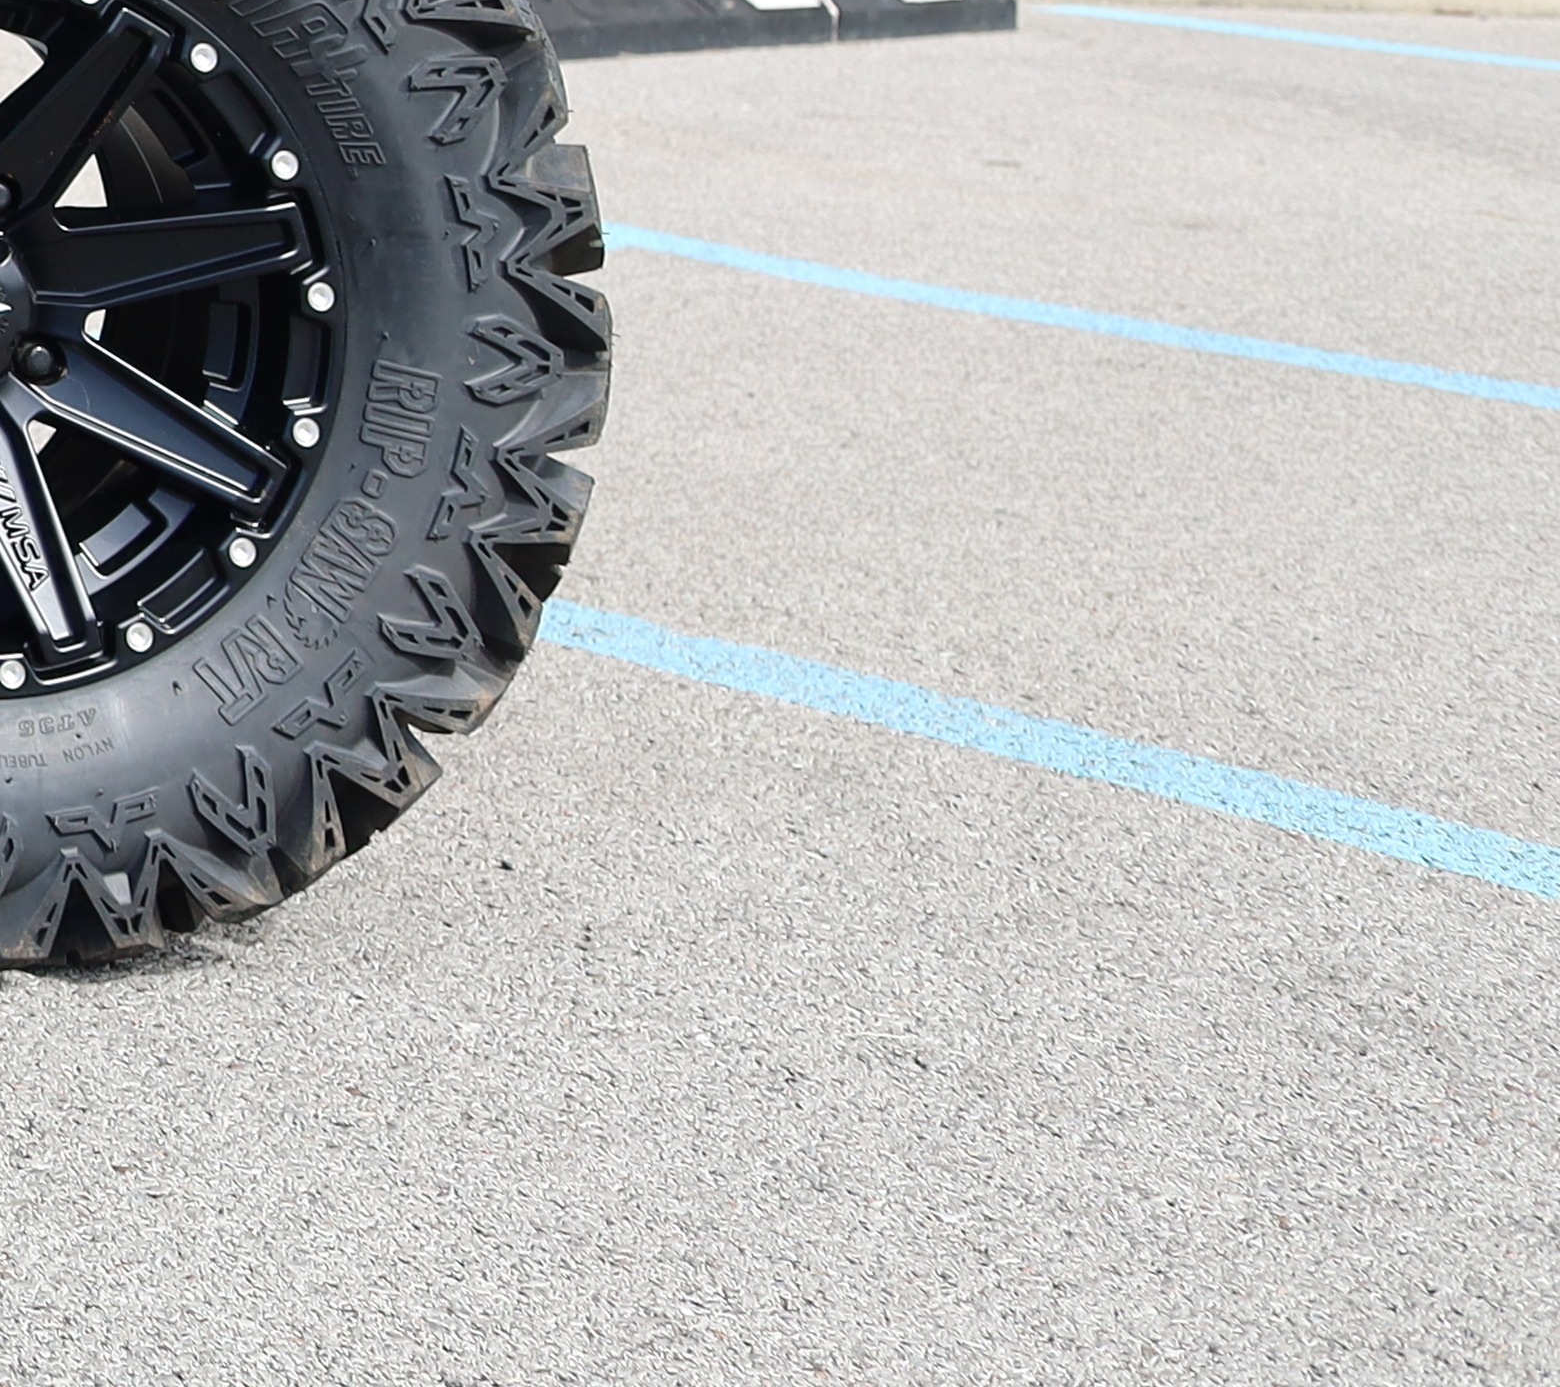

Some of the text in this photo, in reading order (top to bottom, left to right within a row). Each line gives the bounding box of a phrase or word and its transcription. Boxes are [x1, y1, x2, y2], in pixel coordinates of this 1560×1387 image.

[303, 68, 387, 172] TIRE
[194, 358, 443, 728] RIP-SAW R/T
[60, 735, 117, 765] NYLON
